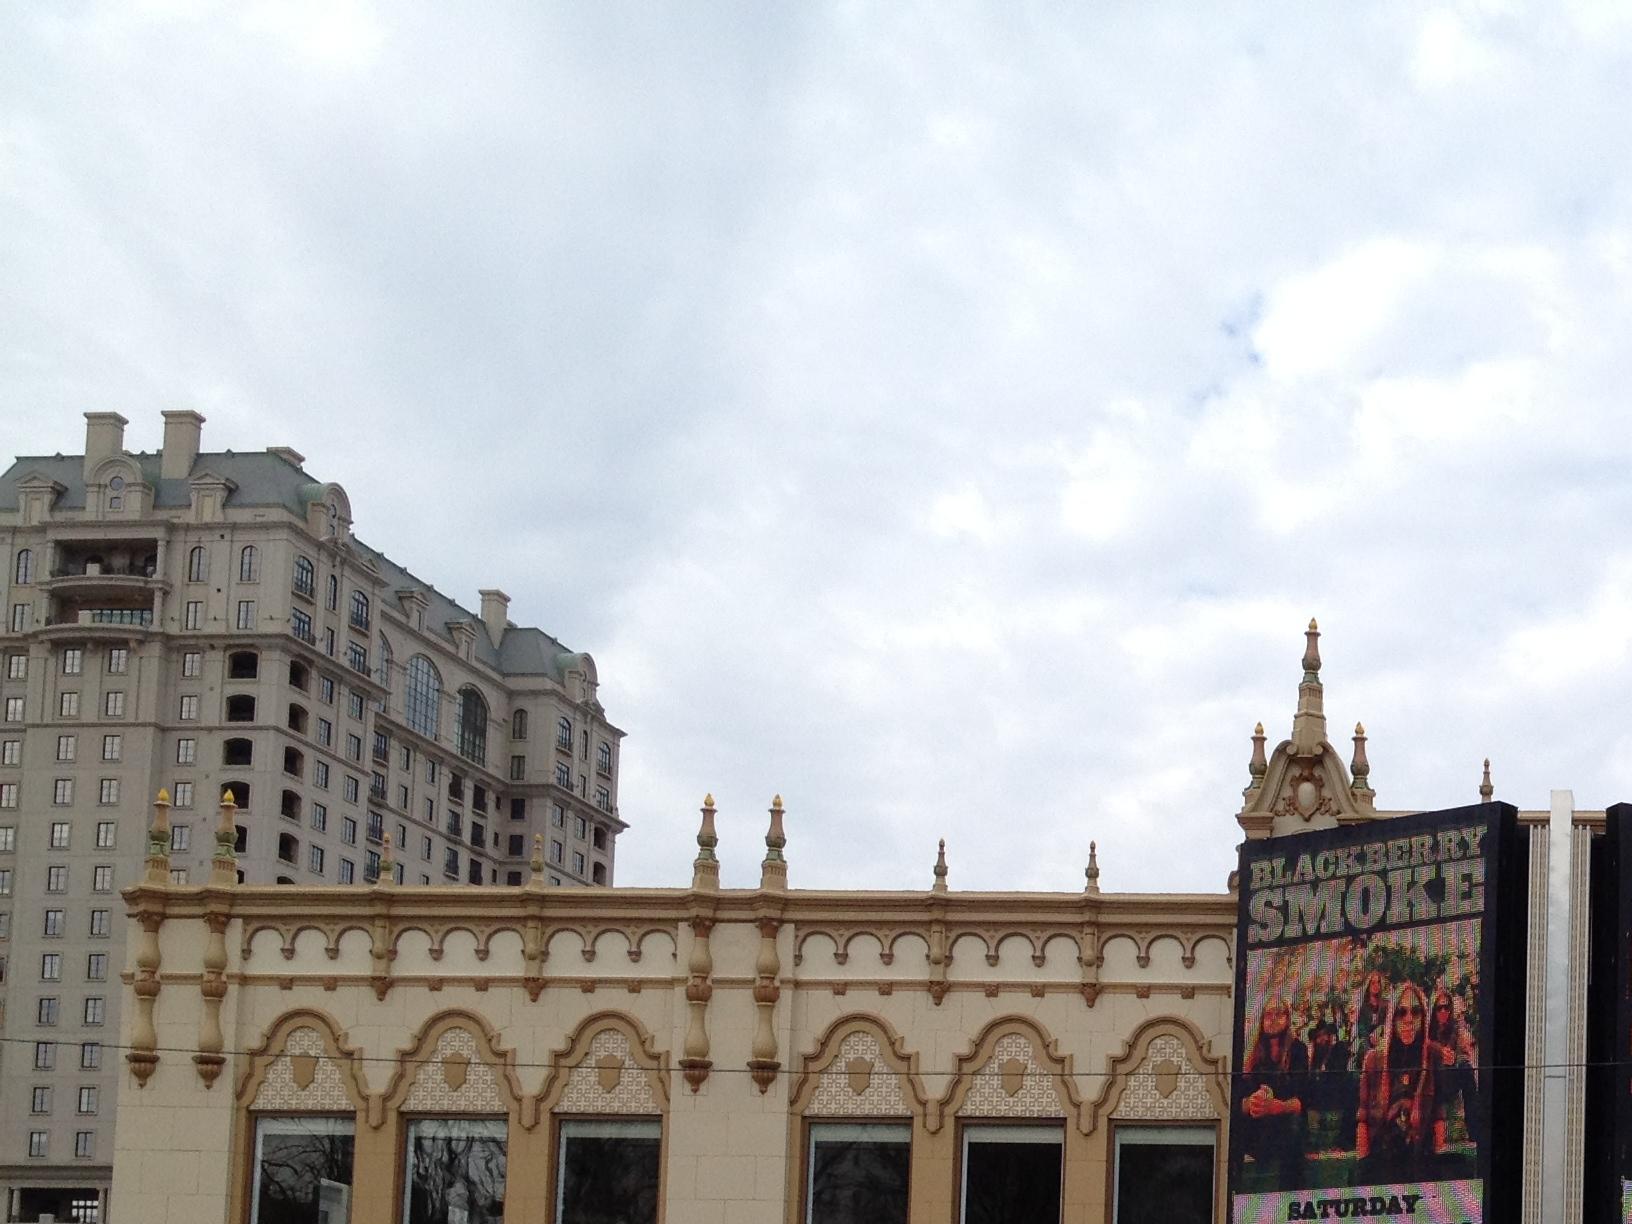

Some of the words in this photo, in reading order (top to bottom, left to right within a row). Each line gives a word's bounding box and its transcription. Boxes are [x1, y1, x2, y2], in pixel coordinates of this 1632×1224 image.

[1250, 825, 1488, 889] BLACKBERRY
[1248, 858, 1486, 944] SMOKE
[1288, 1194, 1420, 1221] SATURDAY
